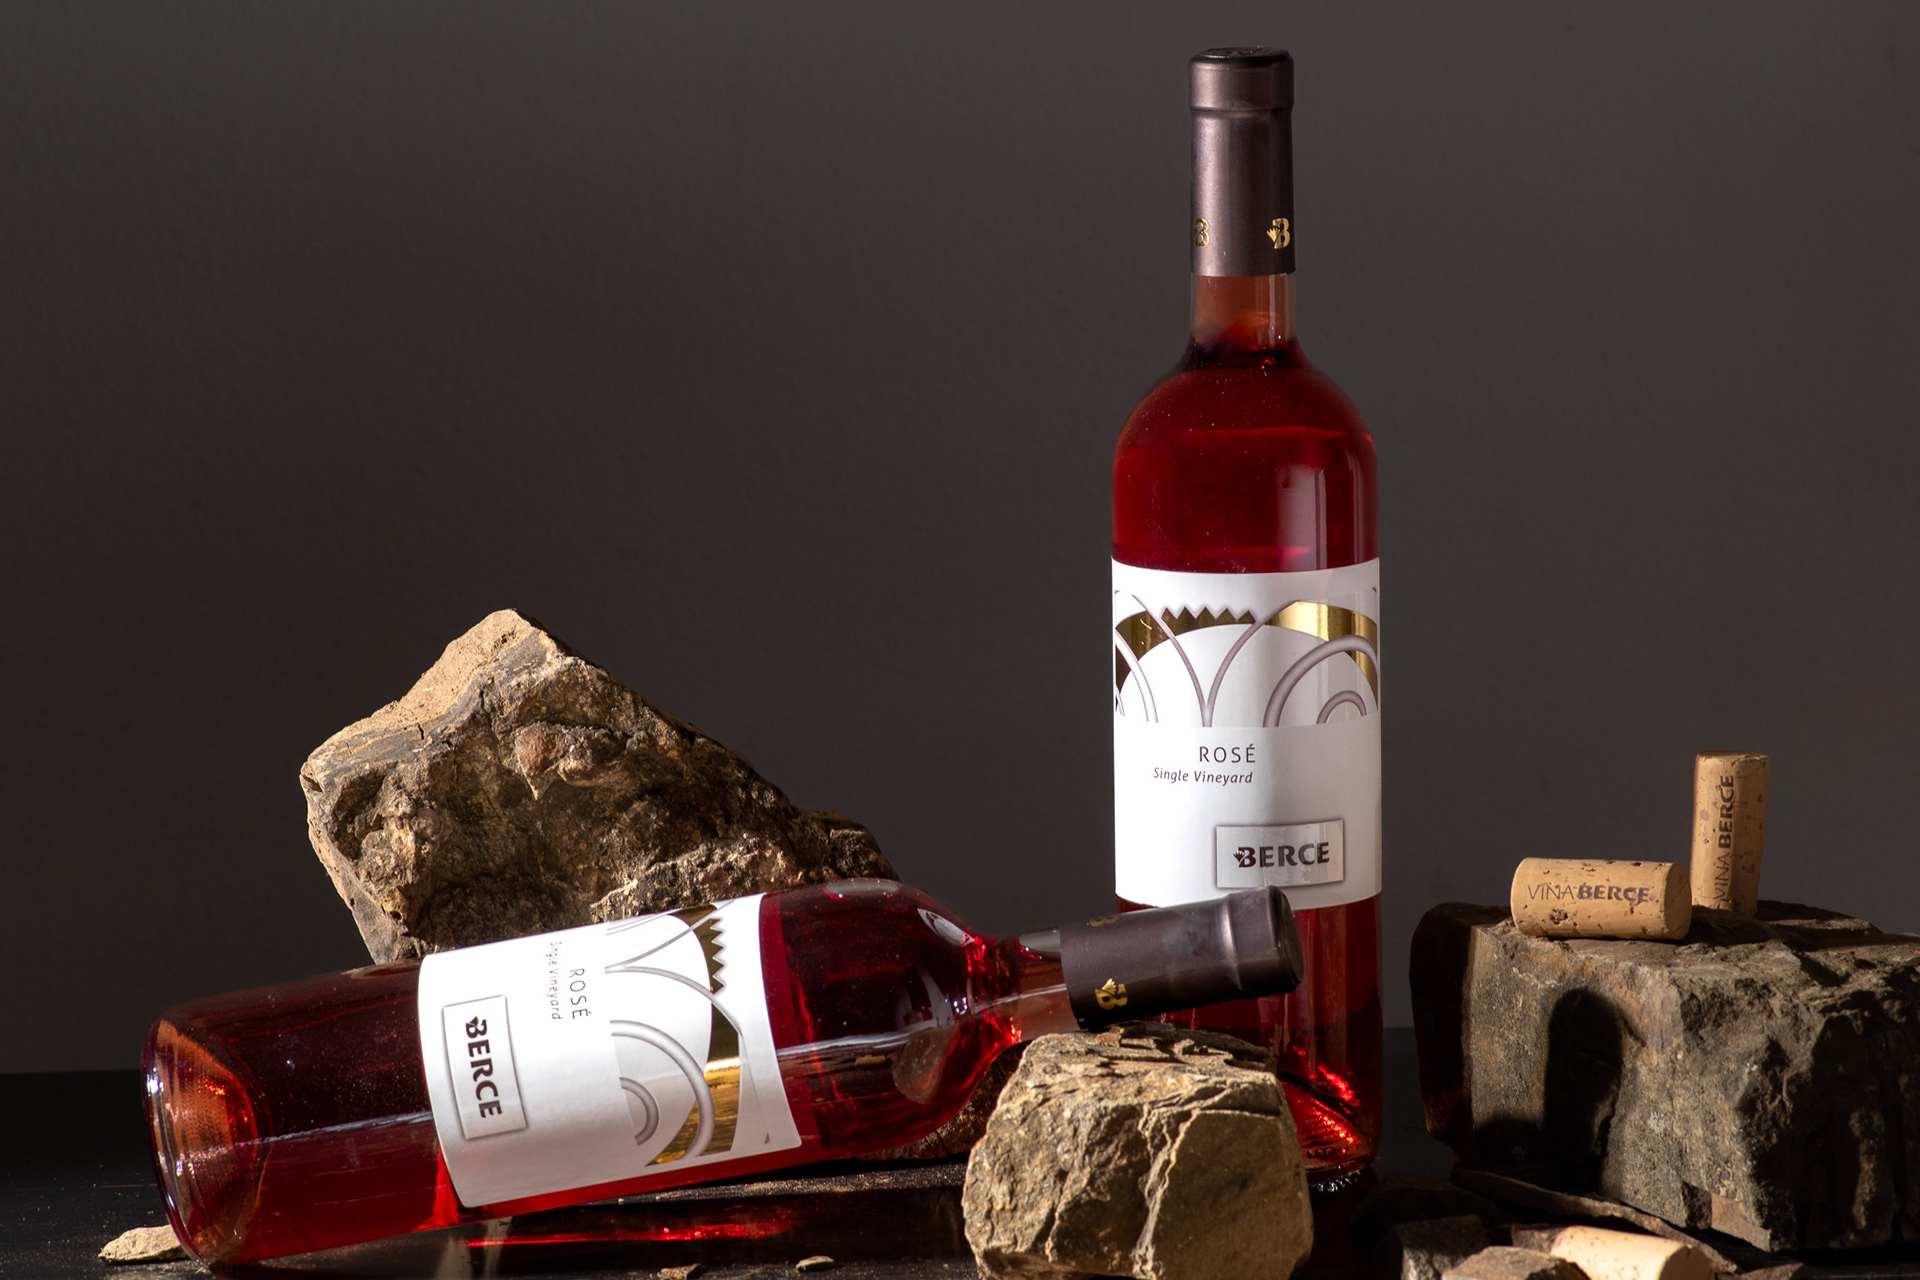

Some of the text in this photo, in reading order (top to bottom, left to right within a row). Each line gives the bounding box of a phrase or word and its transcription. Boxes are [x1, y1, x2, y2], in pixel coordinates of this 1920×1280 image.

[1199, 743, 1256, 764] ROSÉ
[1153, 767, 1253, 786] Single Vineyard
[1233, 842, 1330, 868] BERCE
[546, 968, 563, 1020] Vineyard
[569, 967, 592, 1020] ROSÉ
[465, 1015, 503, 1118] BERCE
